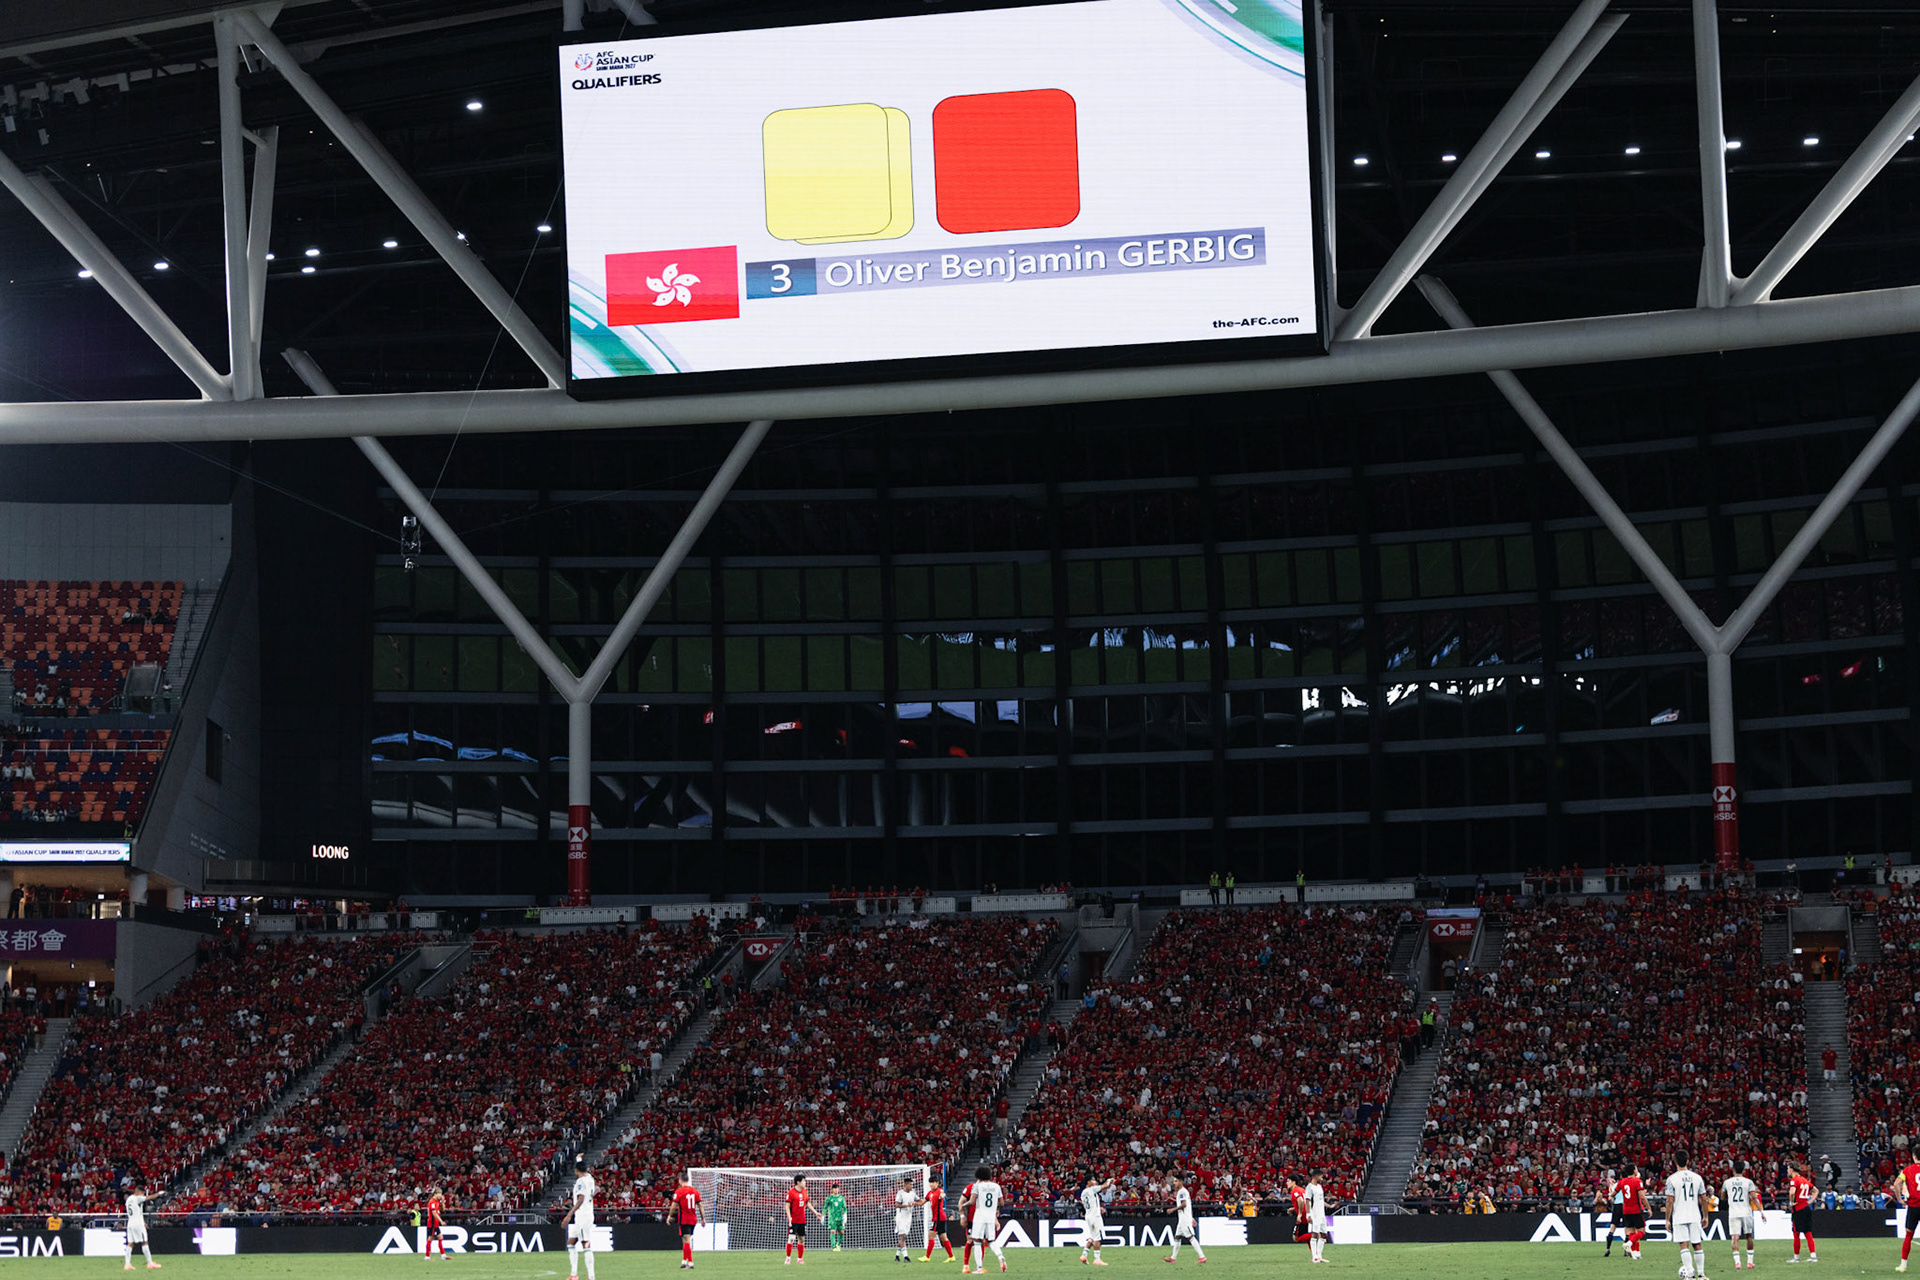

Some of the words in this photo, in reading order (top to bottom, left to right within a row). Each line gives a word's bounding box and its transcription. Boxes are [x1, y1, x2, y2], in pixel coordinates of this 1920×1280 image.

[596, 56, 629, 66] ASIAN
[631, 54, 654, 63] CUP
[572, 73, 662, 90] QUALIFIERS
[770, 263, 792, 293] 3
[825, 259, 930, 287] Oliver
[941, 244, 1106, 283] Benjamin
[1117, 234, 1256, 268] GERBIG
[1212, 316, 1300, 329] the-AFC.com
[1713, 812, 1737, 820] HSBC
[312, 844, 350, 859] LOONG
[1624, 1184, 1631, 1199] 3
[1682, 1182, 1695, 1201] 14
[1732, 1186, 1744, 1203] 22
[1799, 1183, 1810, 1199] 22
[686, 1193, 696, 1209] 11
[985, 1192, 993, 1208] 8
[1529, 1212, 1727, 1242] AISM
[0, 1235, 64, 1257] SIM
